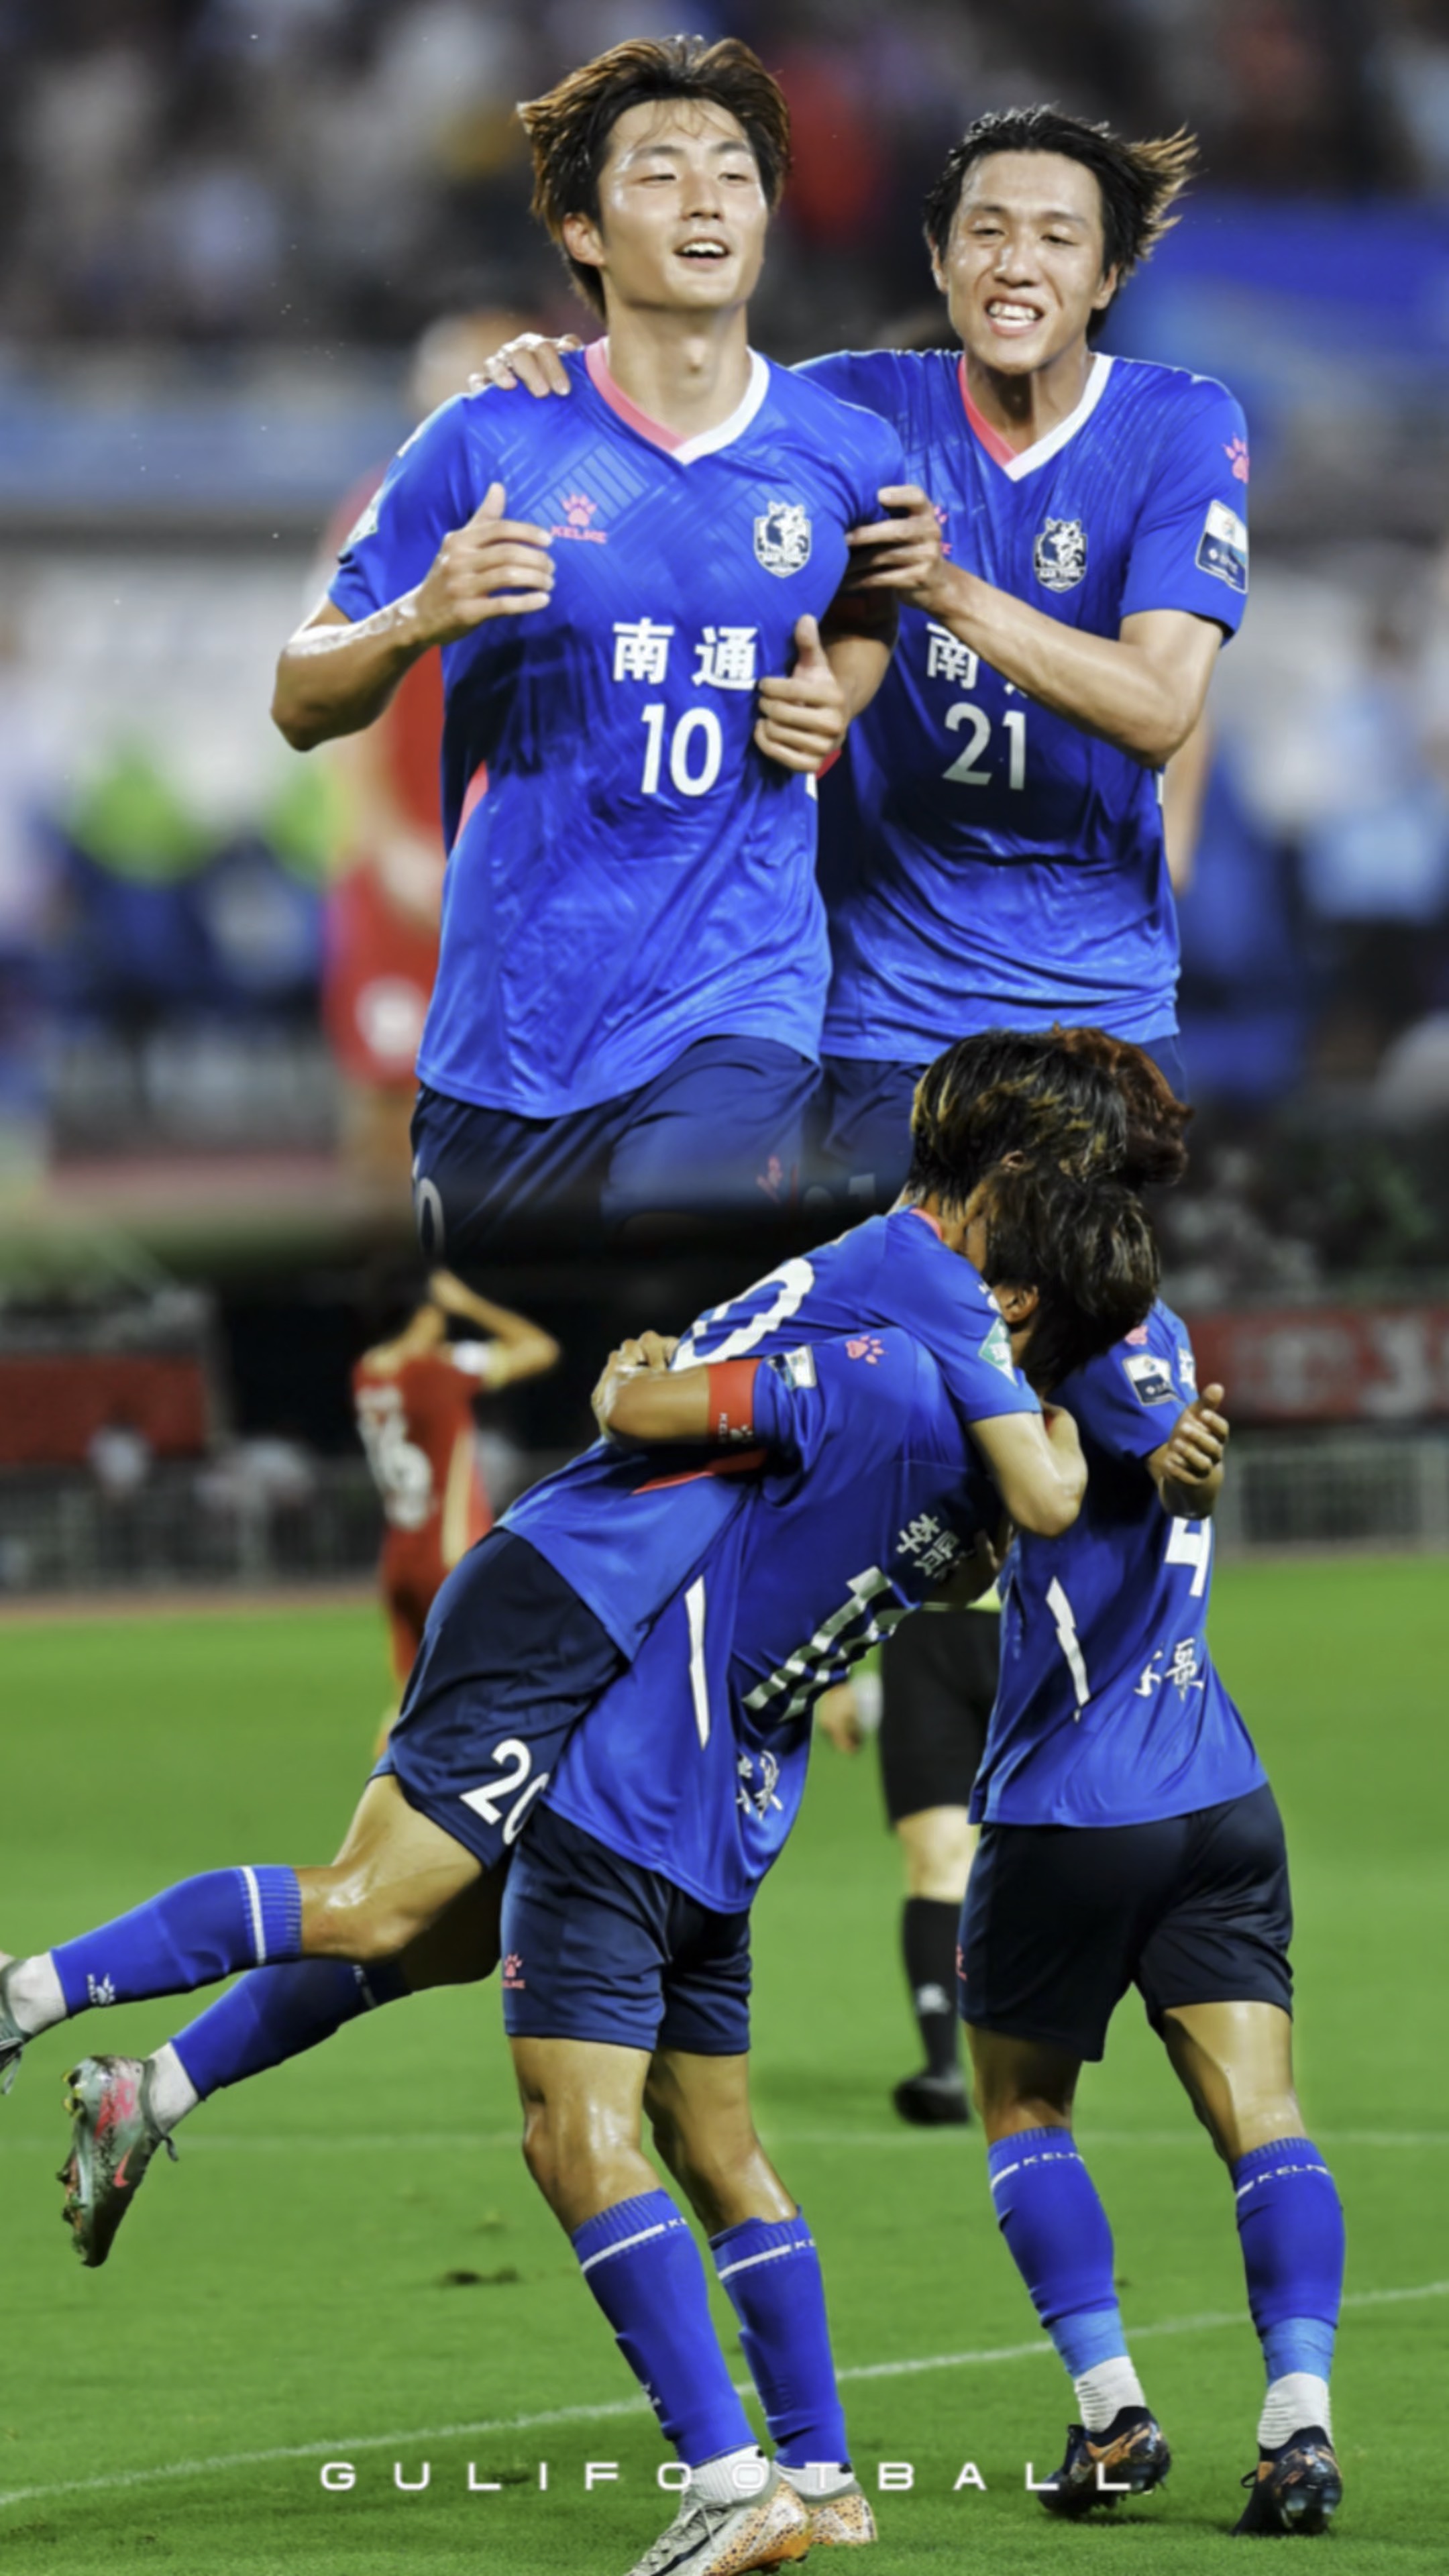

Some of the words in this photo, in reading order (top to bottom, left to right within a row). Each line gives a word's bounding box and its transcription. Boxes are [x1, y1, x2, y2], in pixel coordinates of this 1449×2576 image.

[613, 617, 758, 691] 南通
[926, 621, 1028, 698] 南
[641, 703, 722, 797] 10
[941, 702, 1026, 792] 21
[459, 1737, 550, 1846] 20
